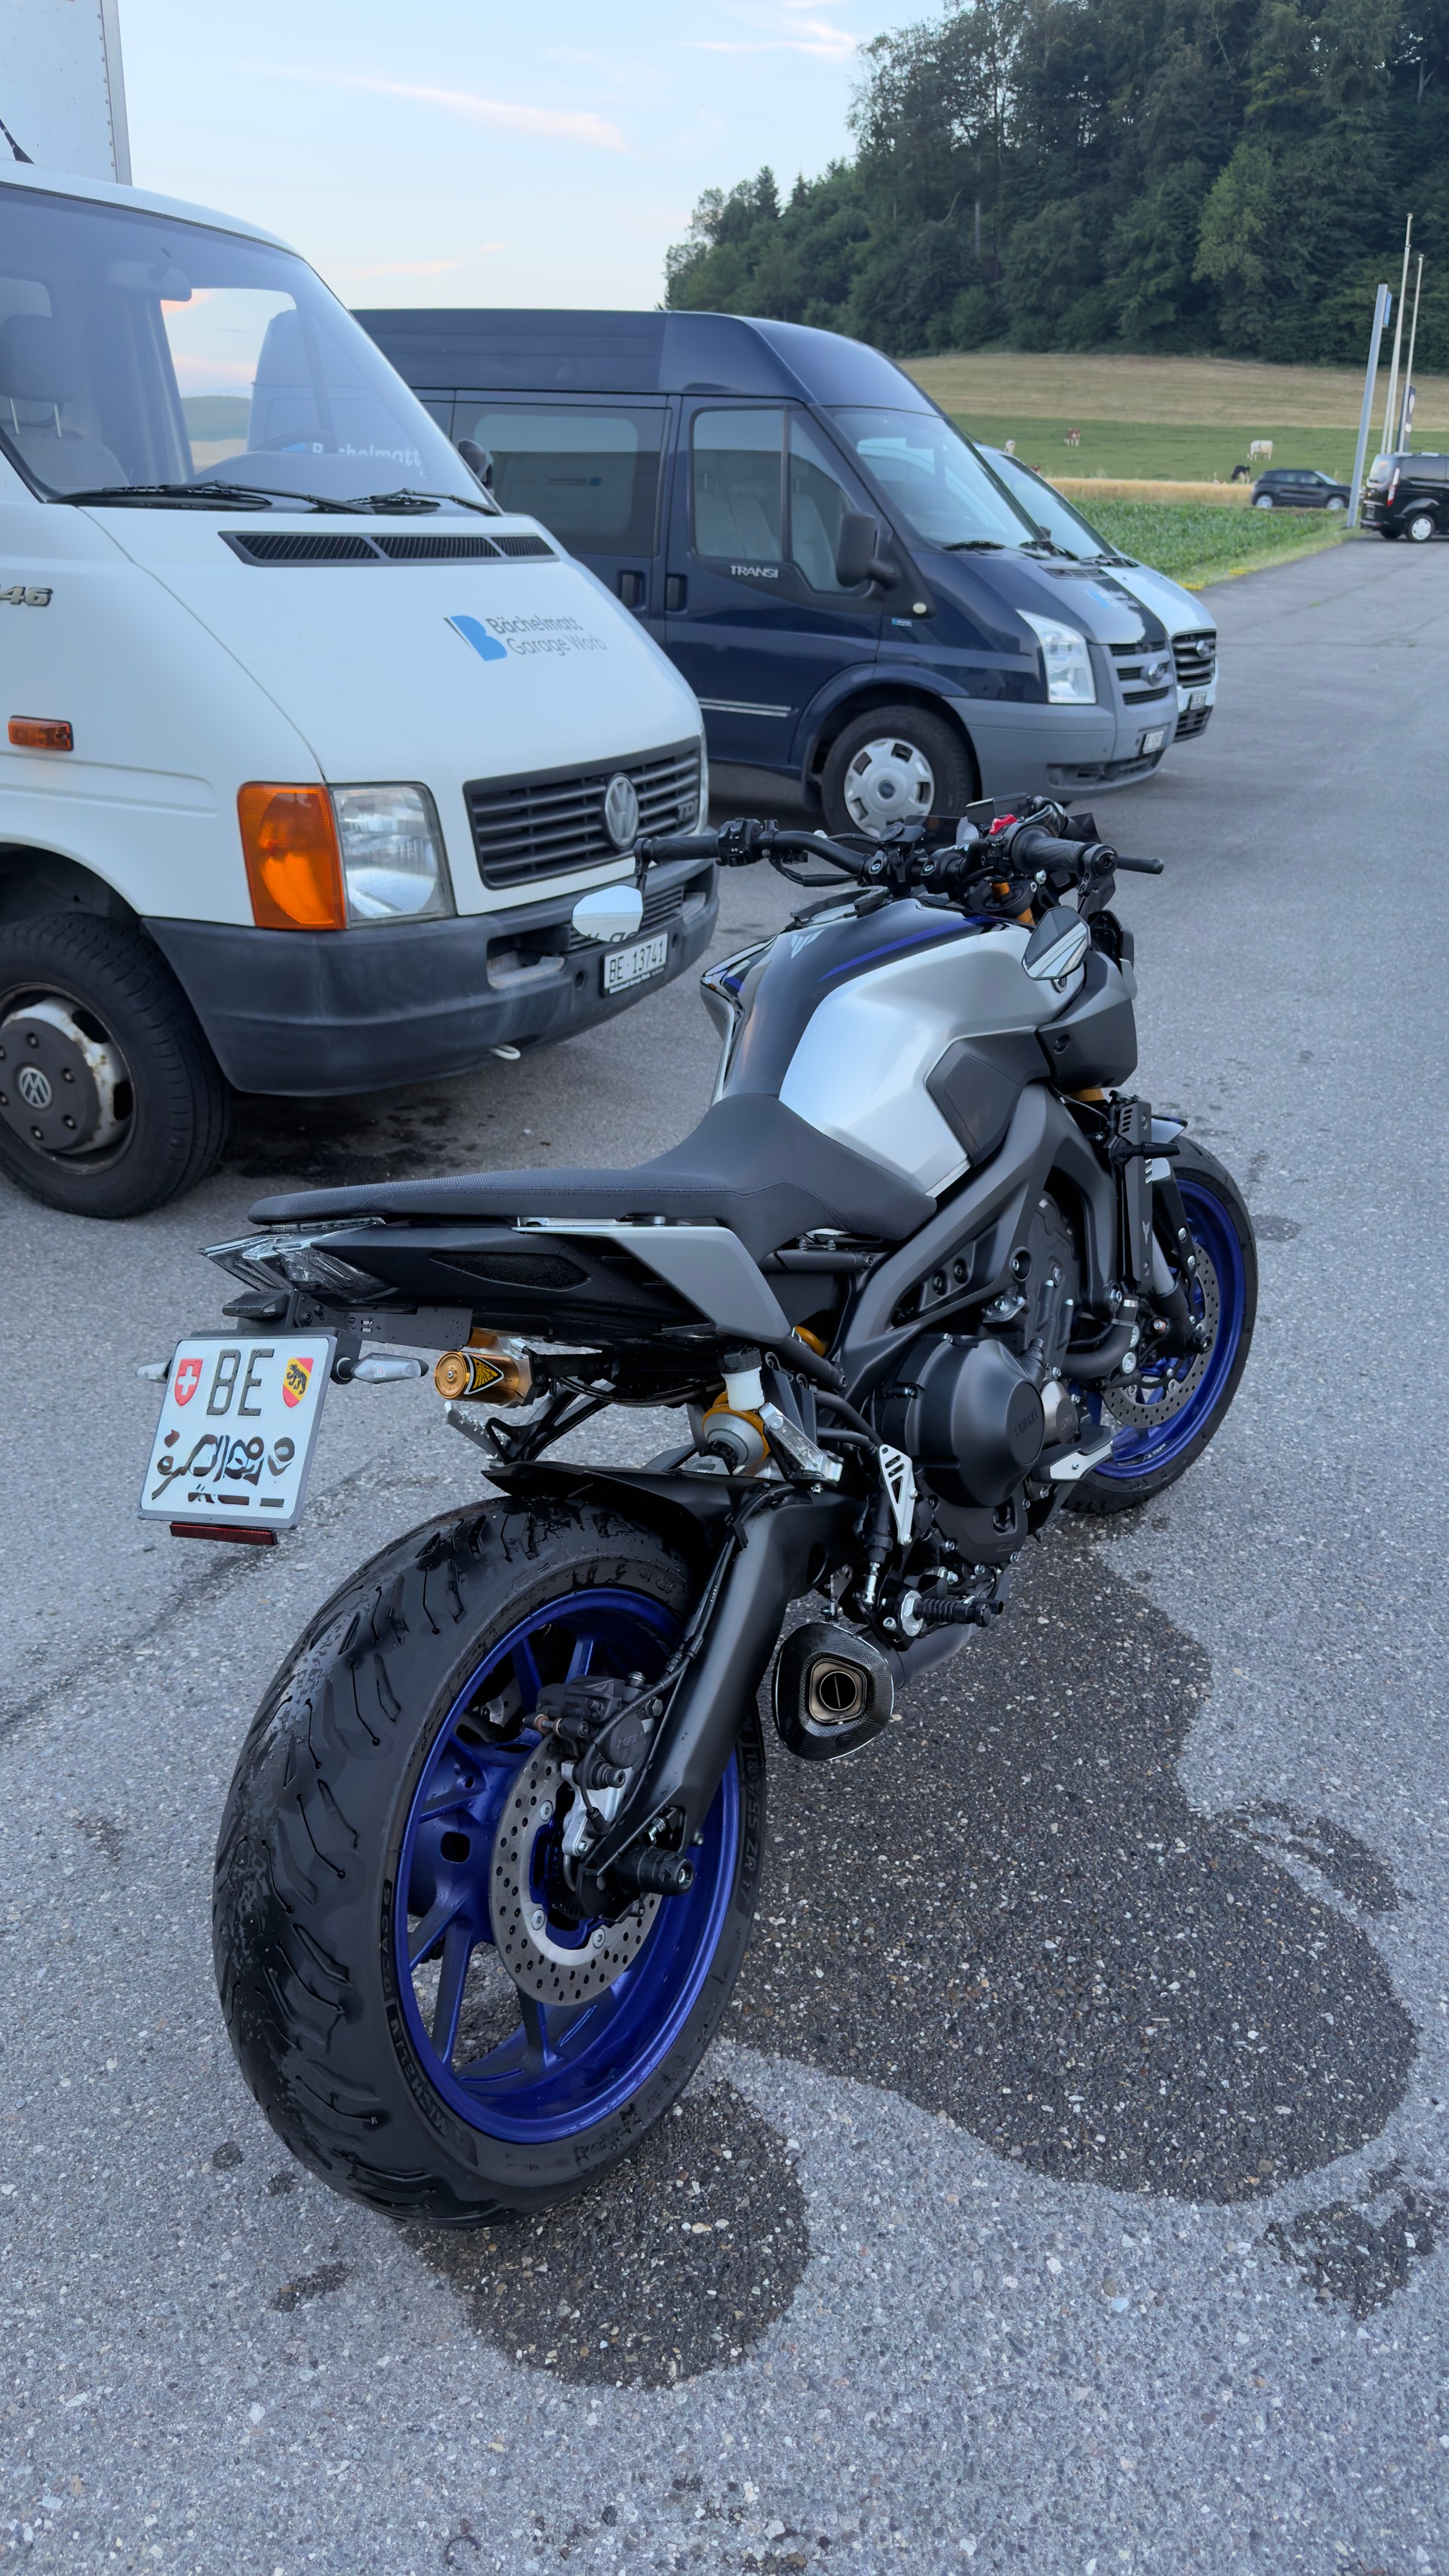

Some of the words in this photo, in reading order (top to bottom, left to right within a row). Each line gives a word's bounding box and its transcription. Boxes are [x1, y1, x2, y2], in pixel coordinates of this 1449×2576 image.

[485, 614, 584, 635] Bächelmatt
[506, 637, 570, 657] Garage
[565, 634, 608, 651] Worb
[206, 1348, 275, 1417] BE
